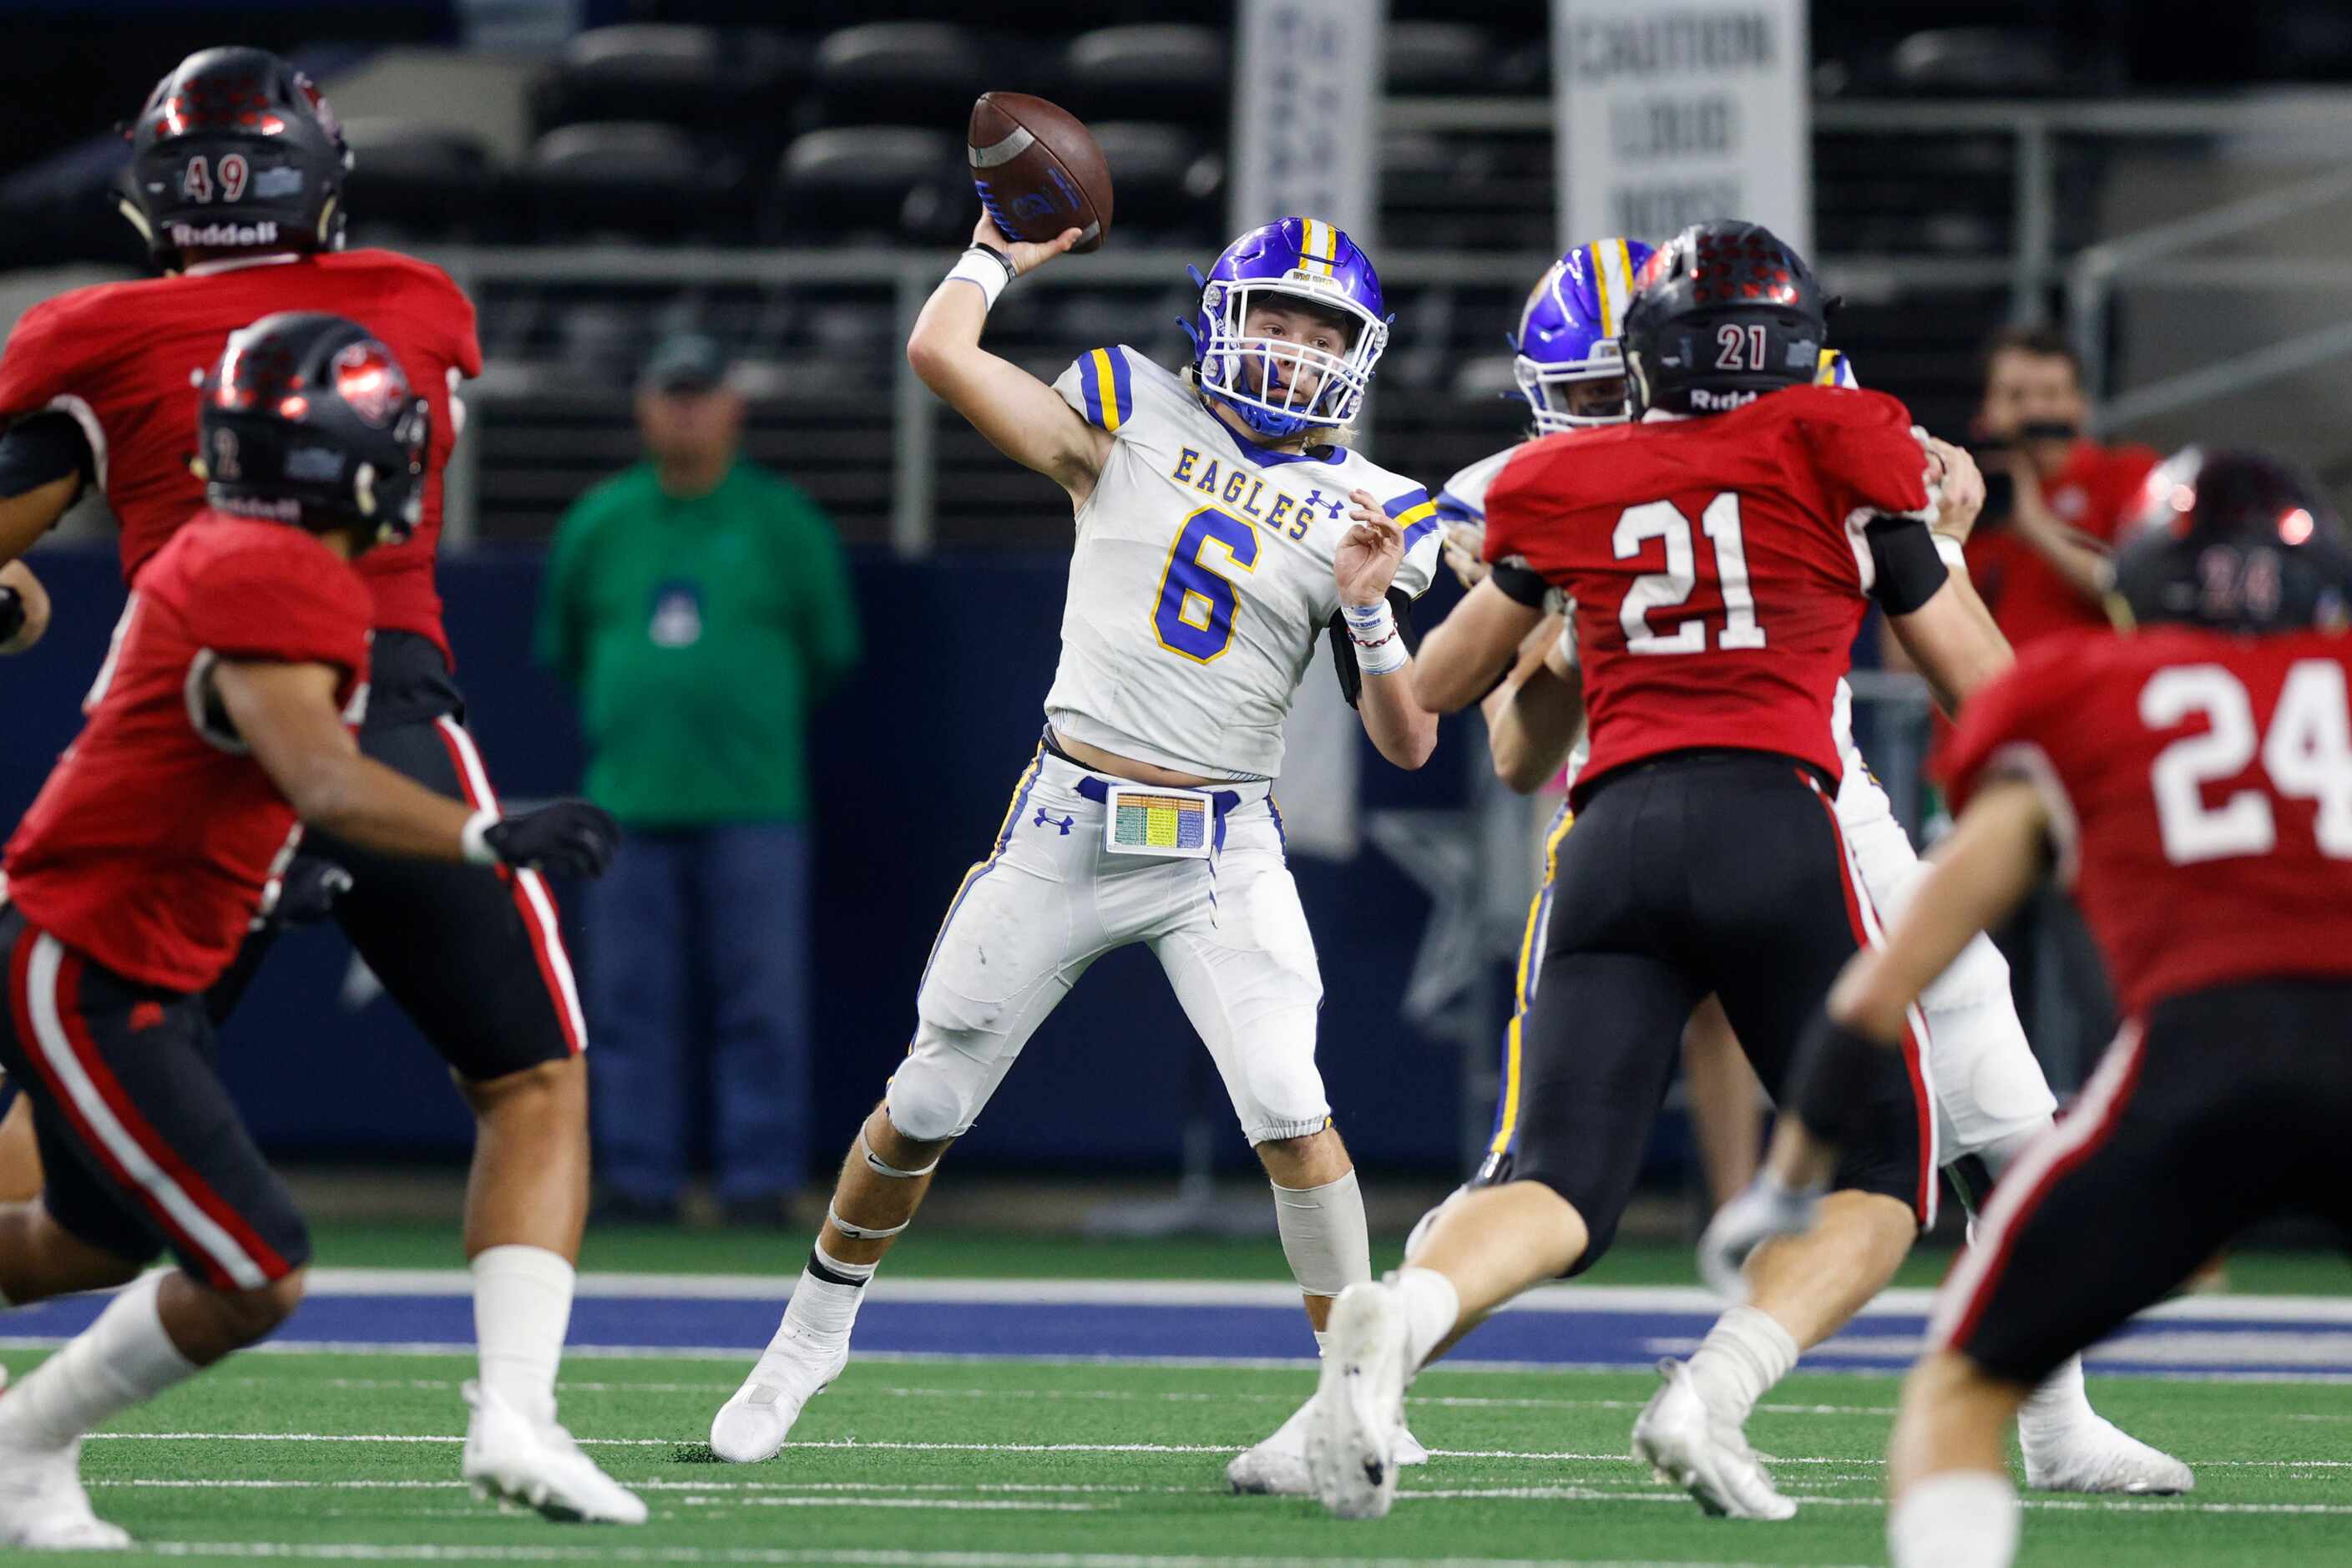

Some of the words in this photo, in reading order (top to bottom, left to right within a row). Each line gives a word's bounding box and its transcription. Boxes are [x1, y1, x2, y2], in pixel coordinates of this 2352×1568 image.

[184, 154, 249, 203] 49
[171, 222, 278, 246] Riddell
[1715, 324, 1766, 371] 21
[1170, 444, 1317, 544] EAGLES
[1151, 502, 1262, 666] 6
[1612, 491, 1767, 655] 21
[2137, 656, 2352, 866] 24
